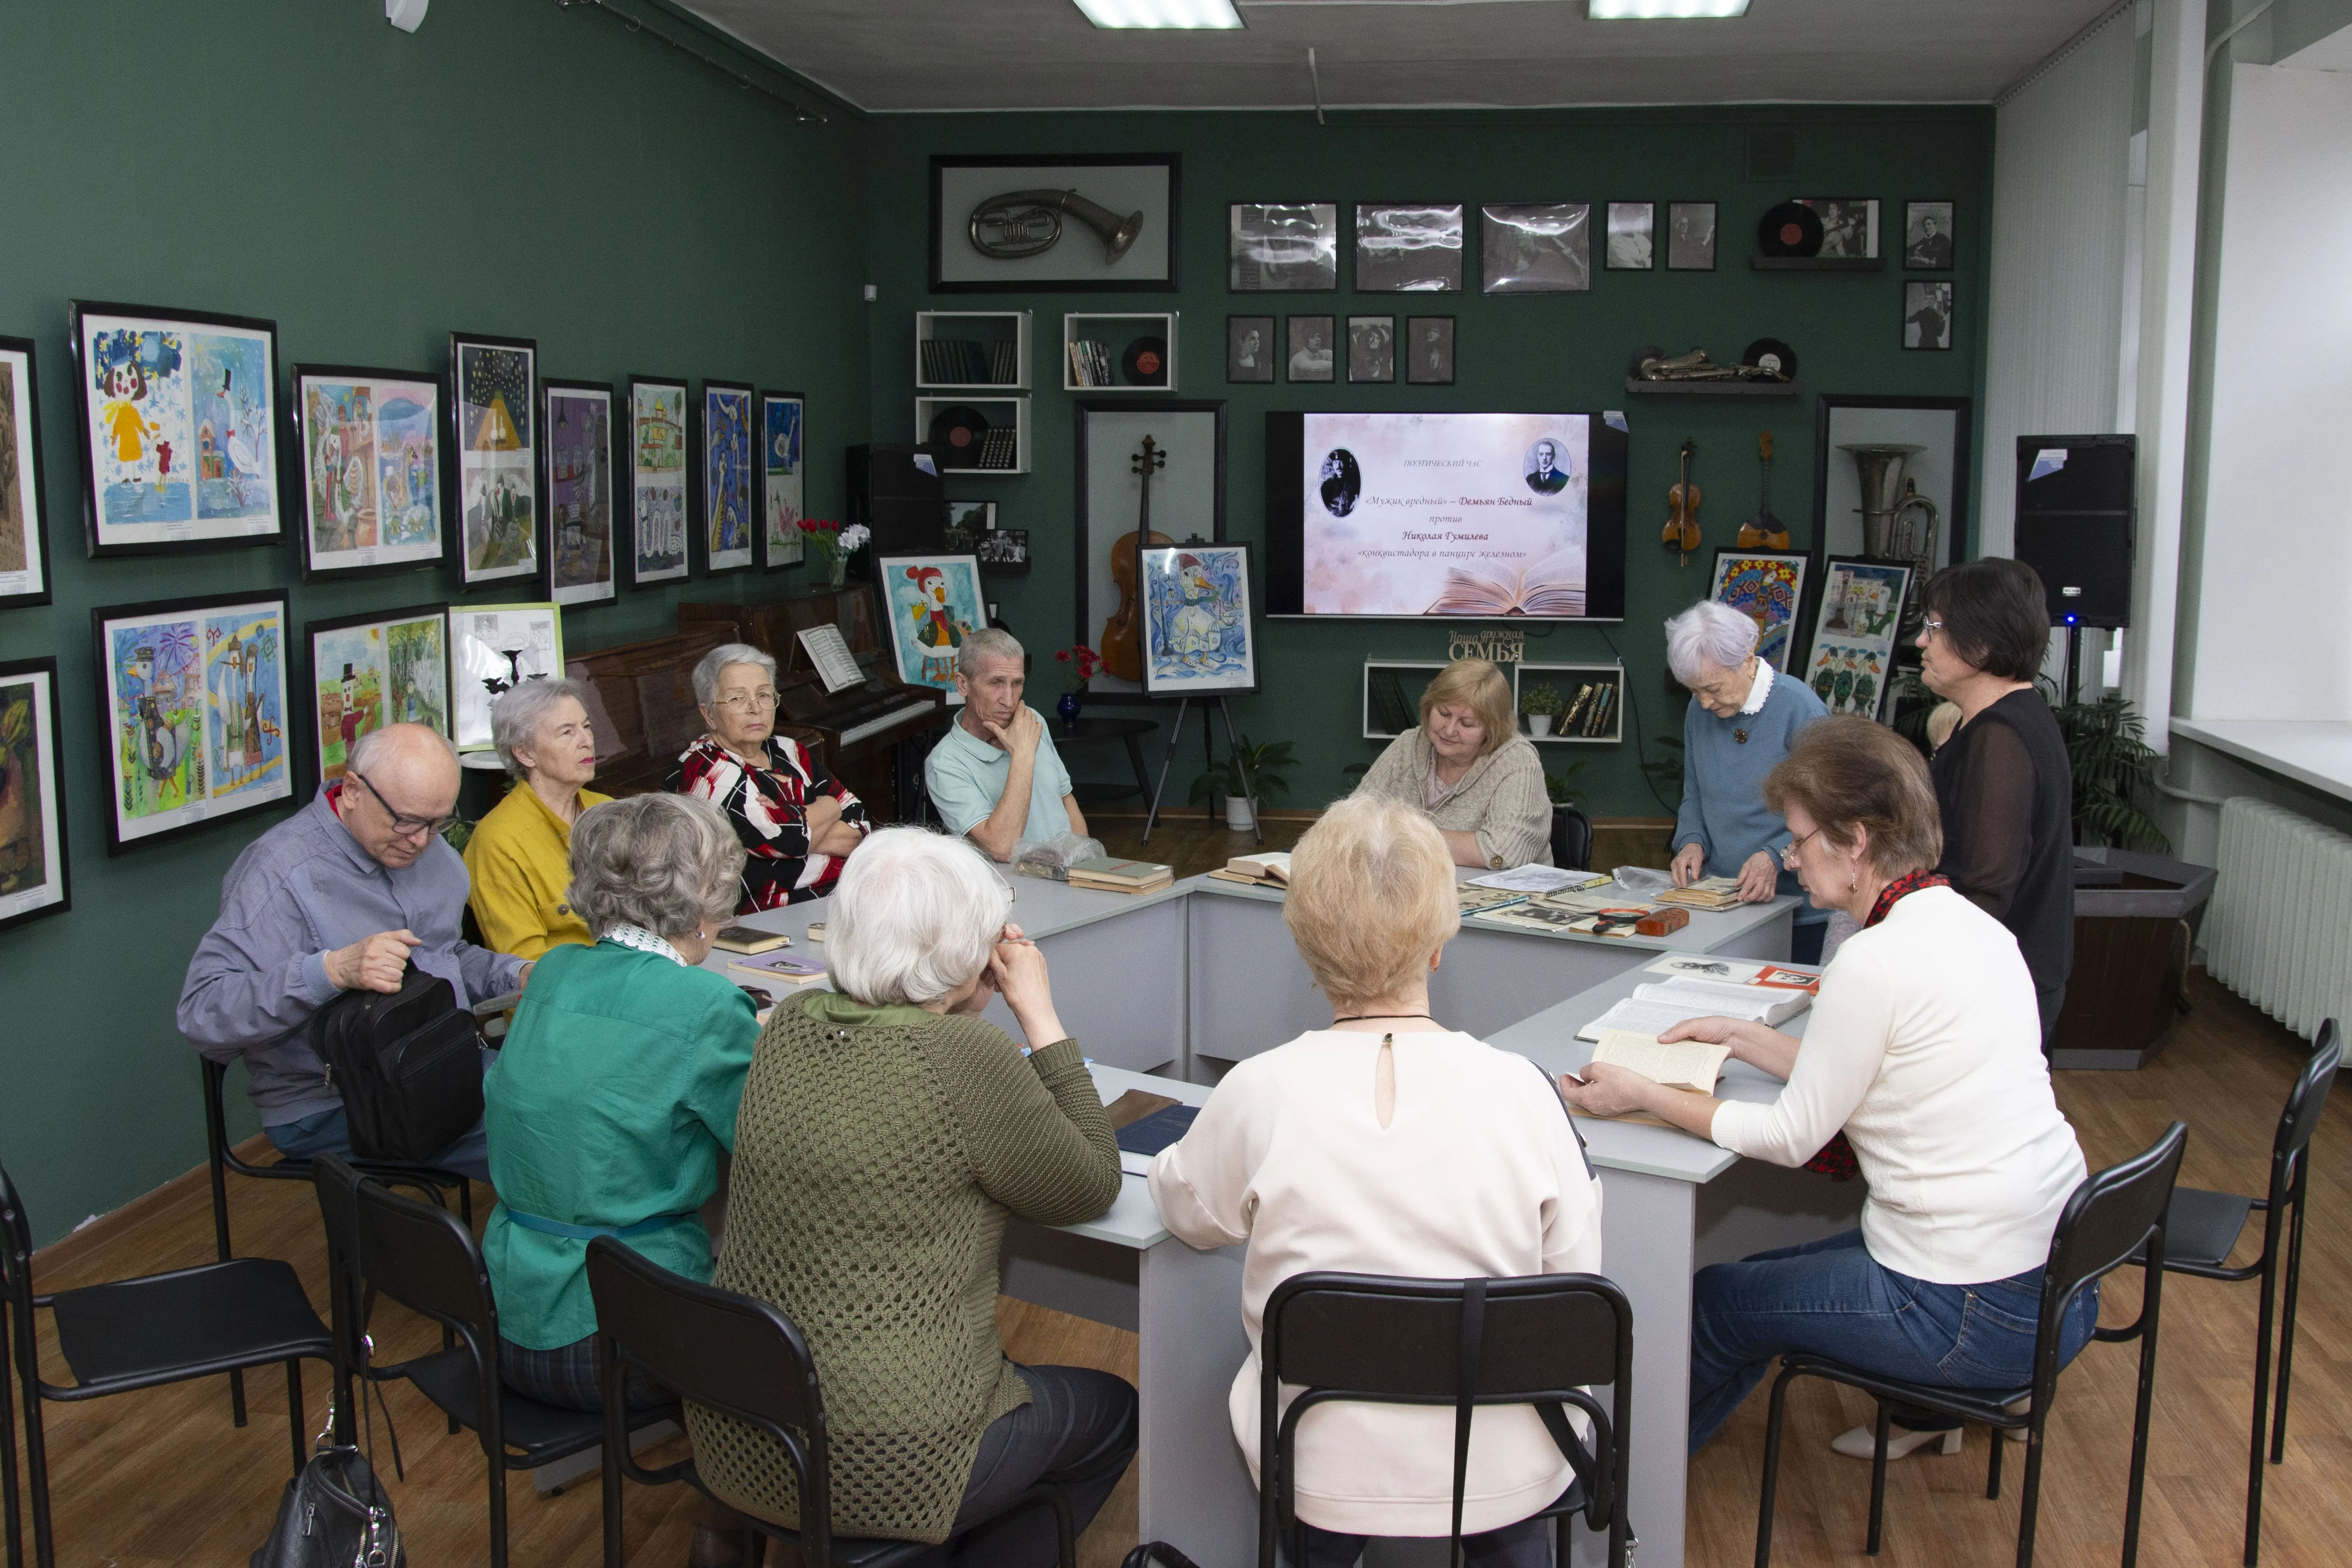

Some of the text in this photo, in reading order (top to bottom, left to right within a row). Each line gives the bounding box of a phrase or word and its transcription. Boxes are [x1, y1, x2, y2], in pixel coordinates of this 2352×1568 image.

[1404, 459, 1465, 467] ПОЭТИЧЕСКИЙ
[1365, 496, 1405, 508] «Мужик
[1405, 496, 1447, 507] вредный»
[1459, 497, 1496, 506] Демьян
[1497, 496, 1533, 506] Бедный
[1429, 516, 1462, 525] против
[1402, 531, 1489, 543] Николая Гумилева
[1358, 547, 1429, 560] «конквистадора
[1439, 550, 1476, 560] панцире
[1477, 550, 1527, 560] железном»
[1449, 631, 1524, 644] Наша дружная
[1449, 642, 1525, 663] СЕМЬЯ
